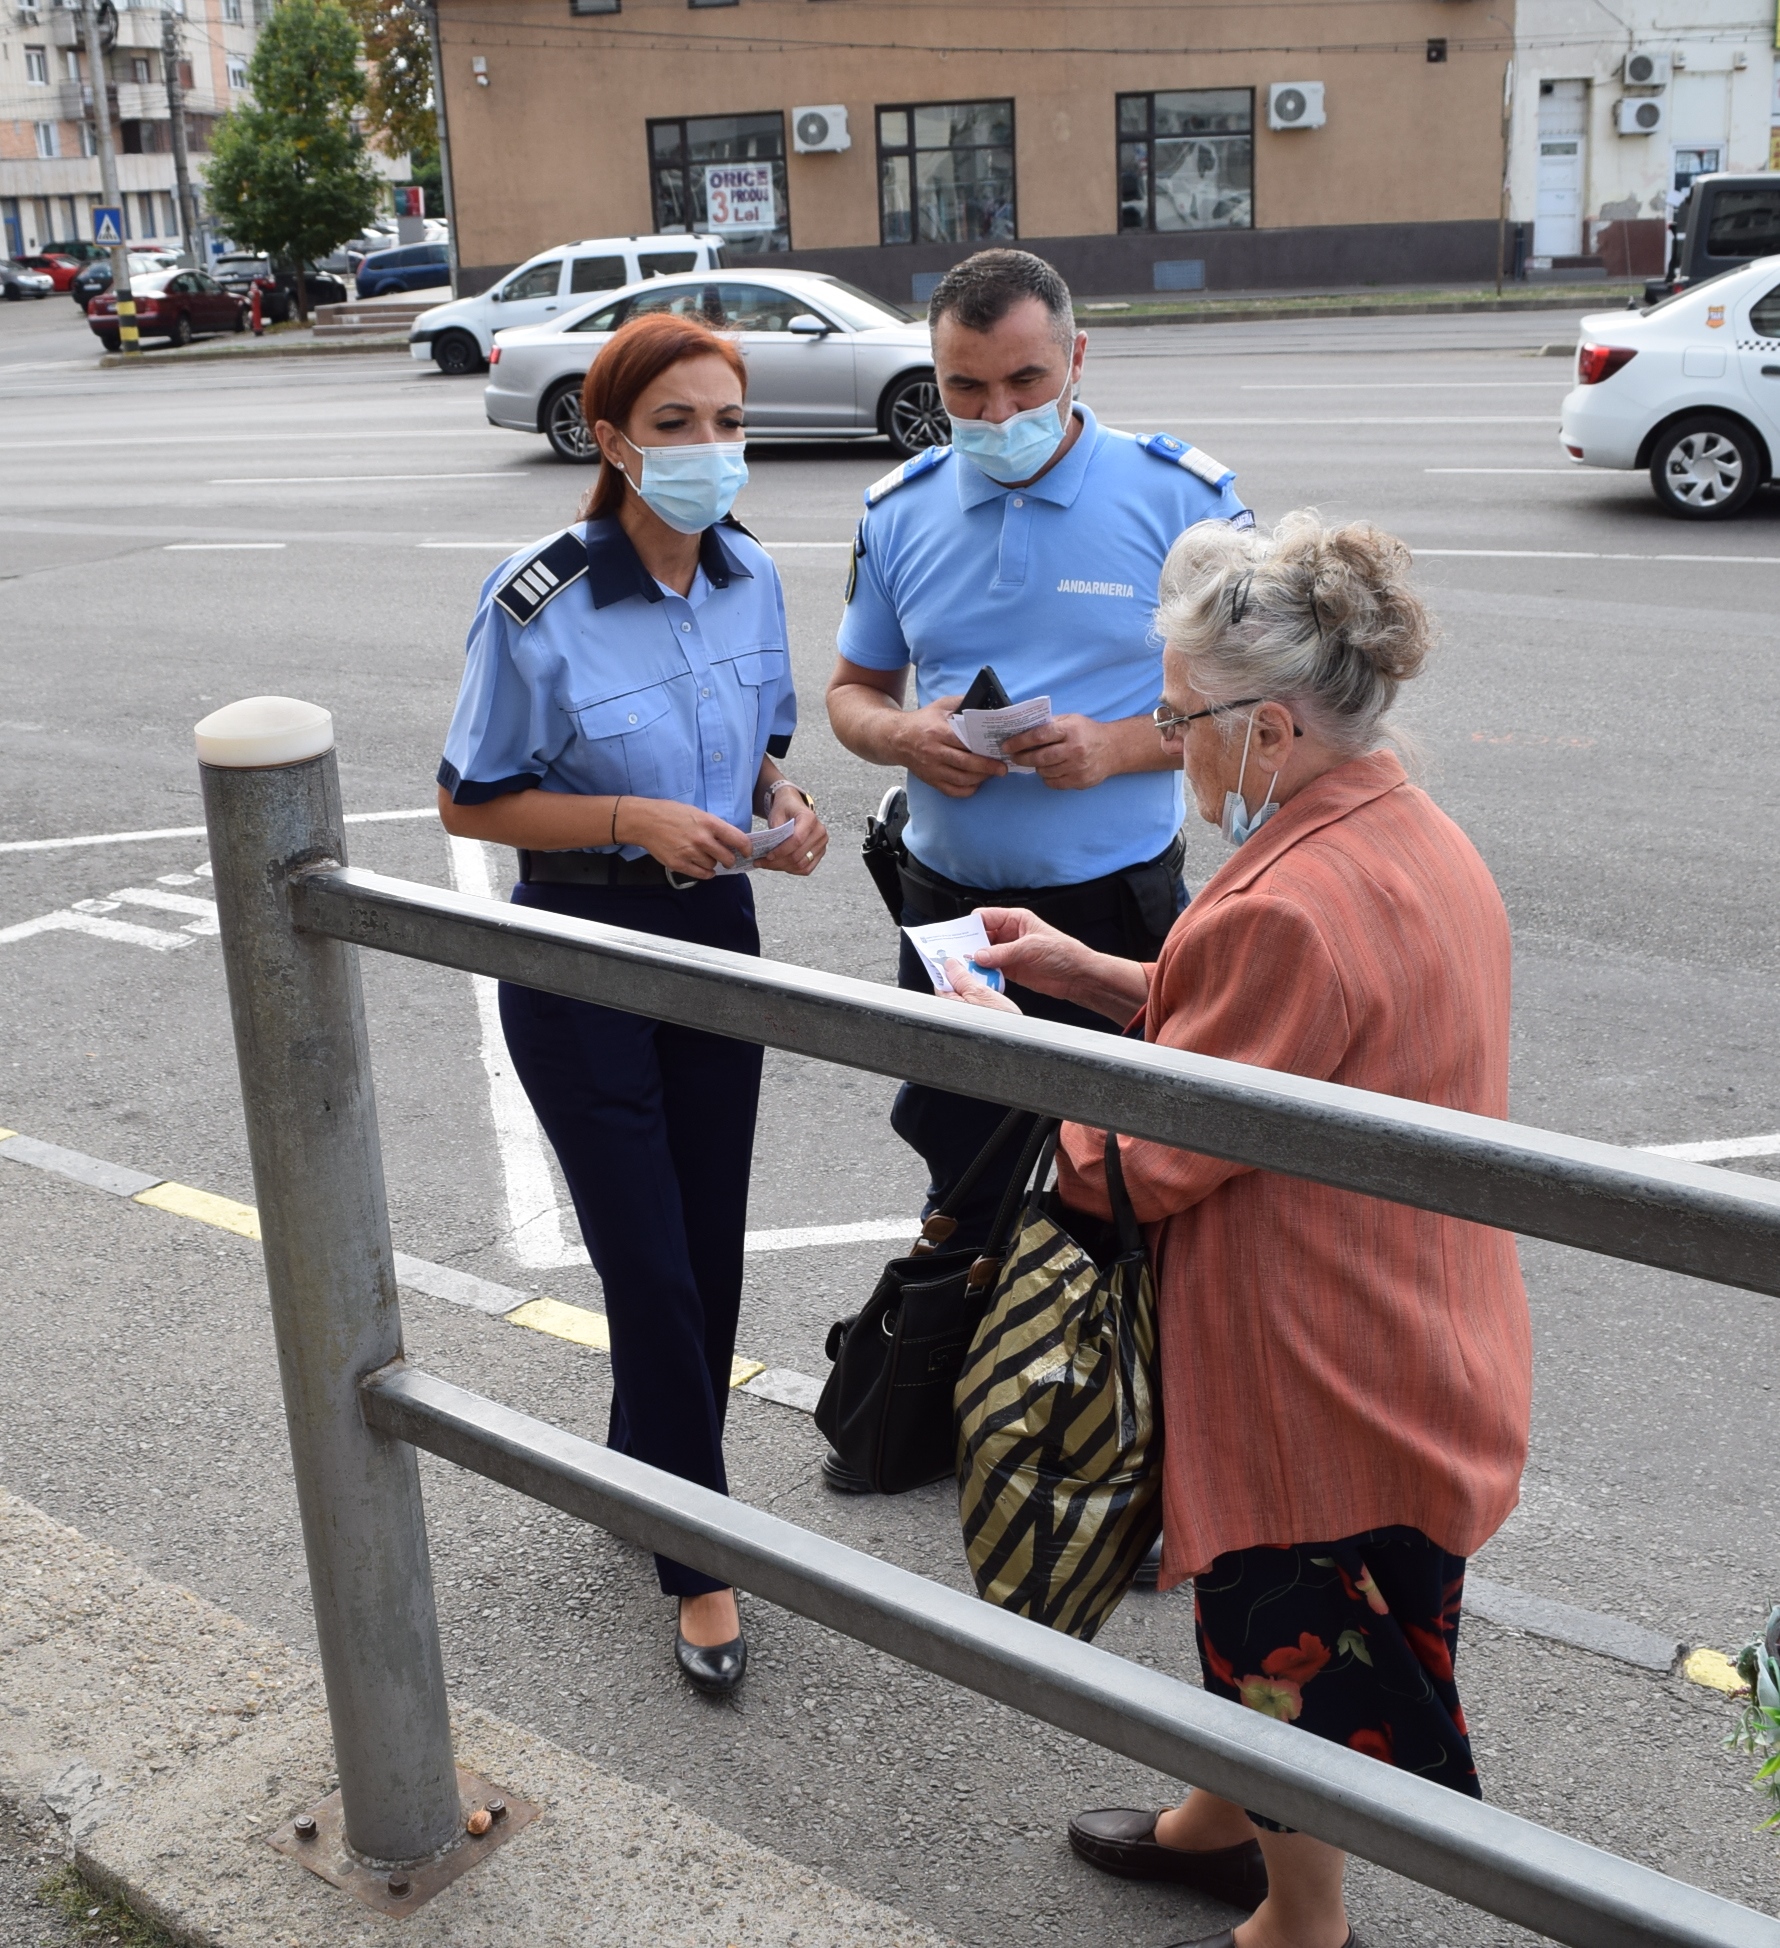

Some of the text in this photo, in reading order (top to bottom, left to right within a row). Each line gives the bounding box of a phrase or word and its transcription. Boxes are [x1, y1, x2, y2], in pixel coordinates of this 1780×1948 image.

[710, 170, 768, 188] ORICE
[712, 191, 729, 223] 3
[1057, 579, 1134, 598] JANDARMERIA
